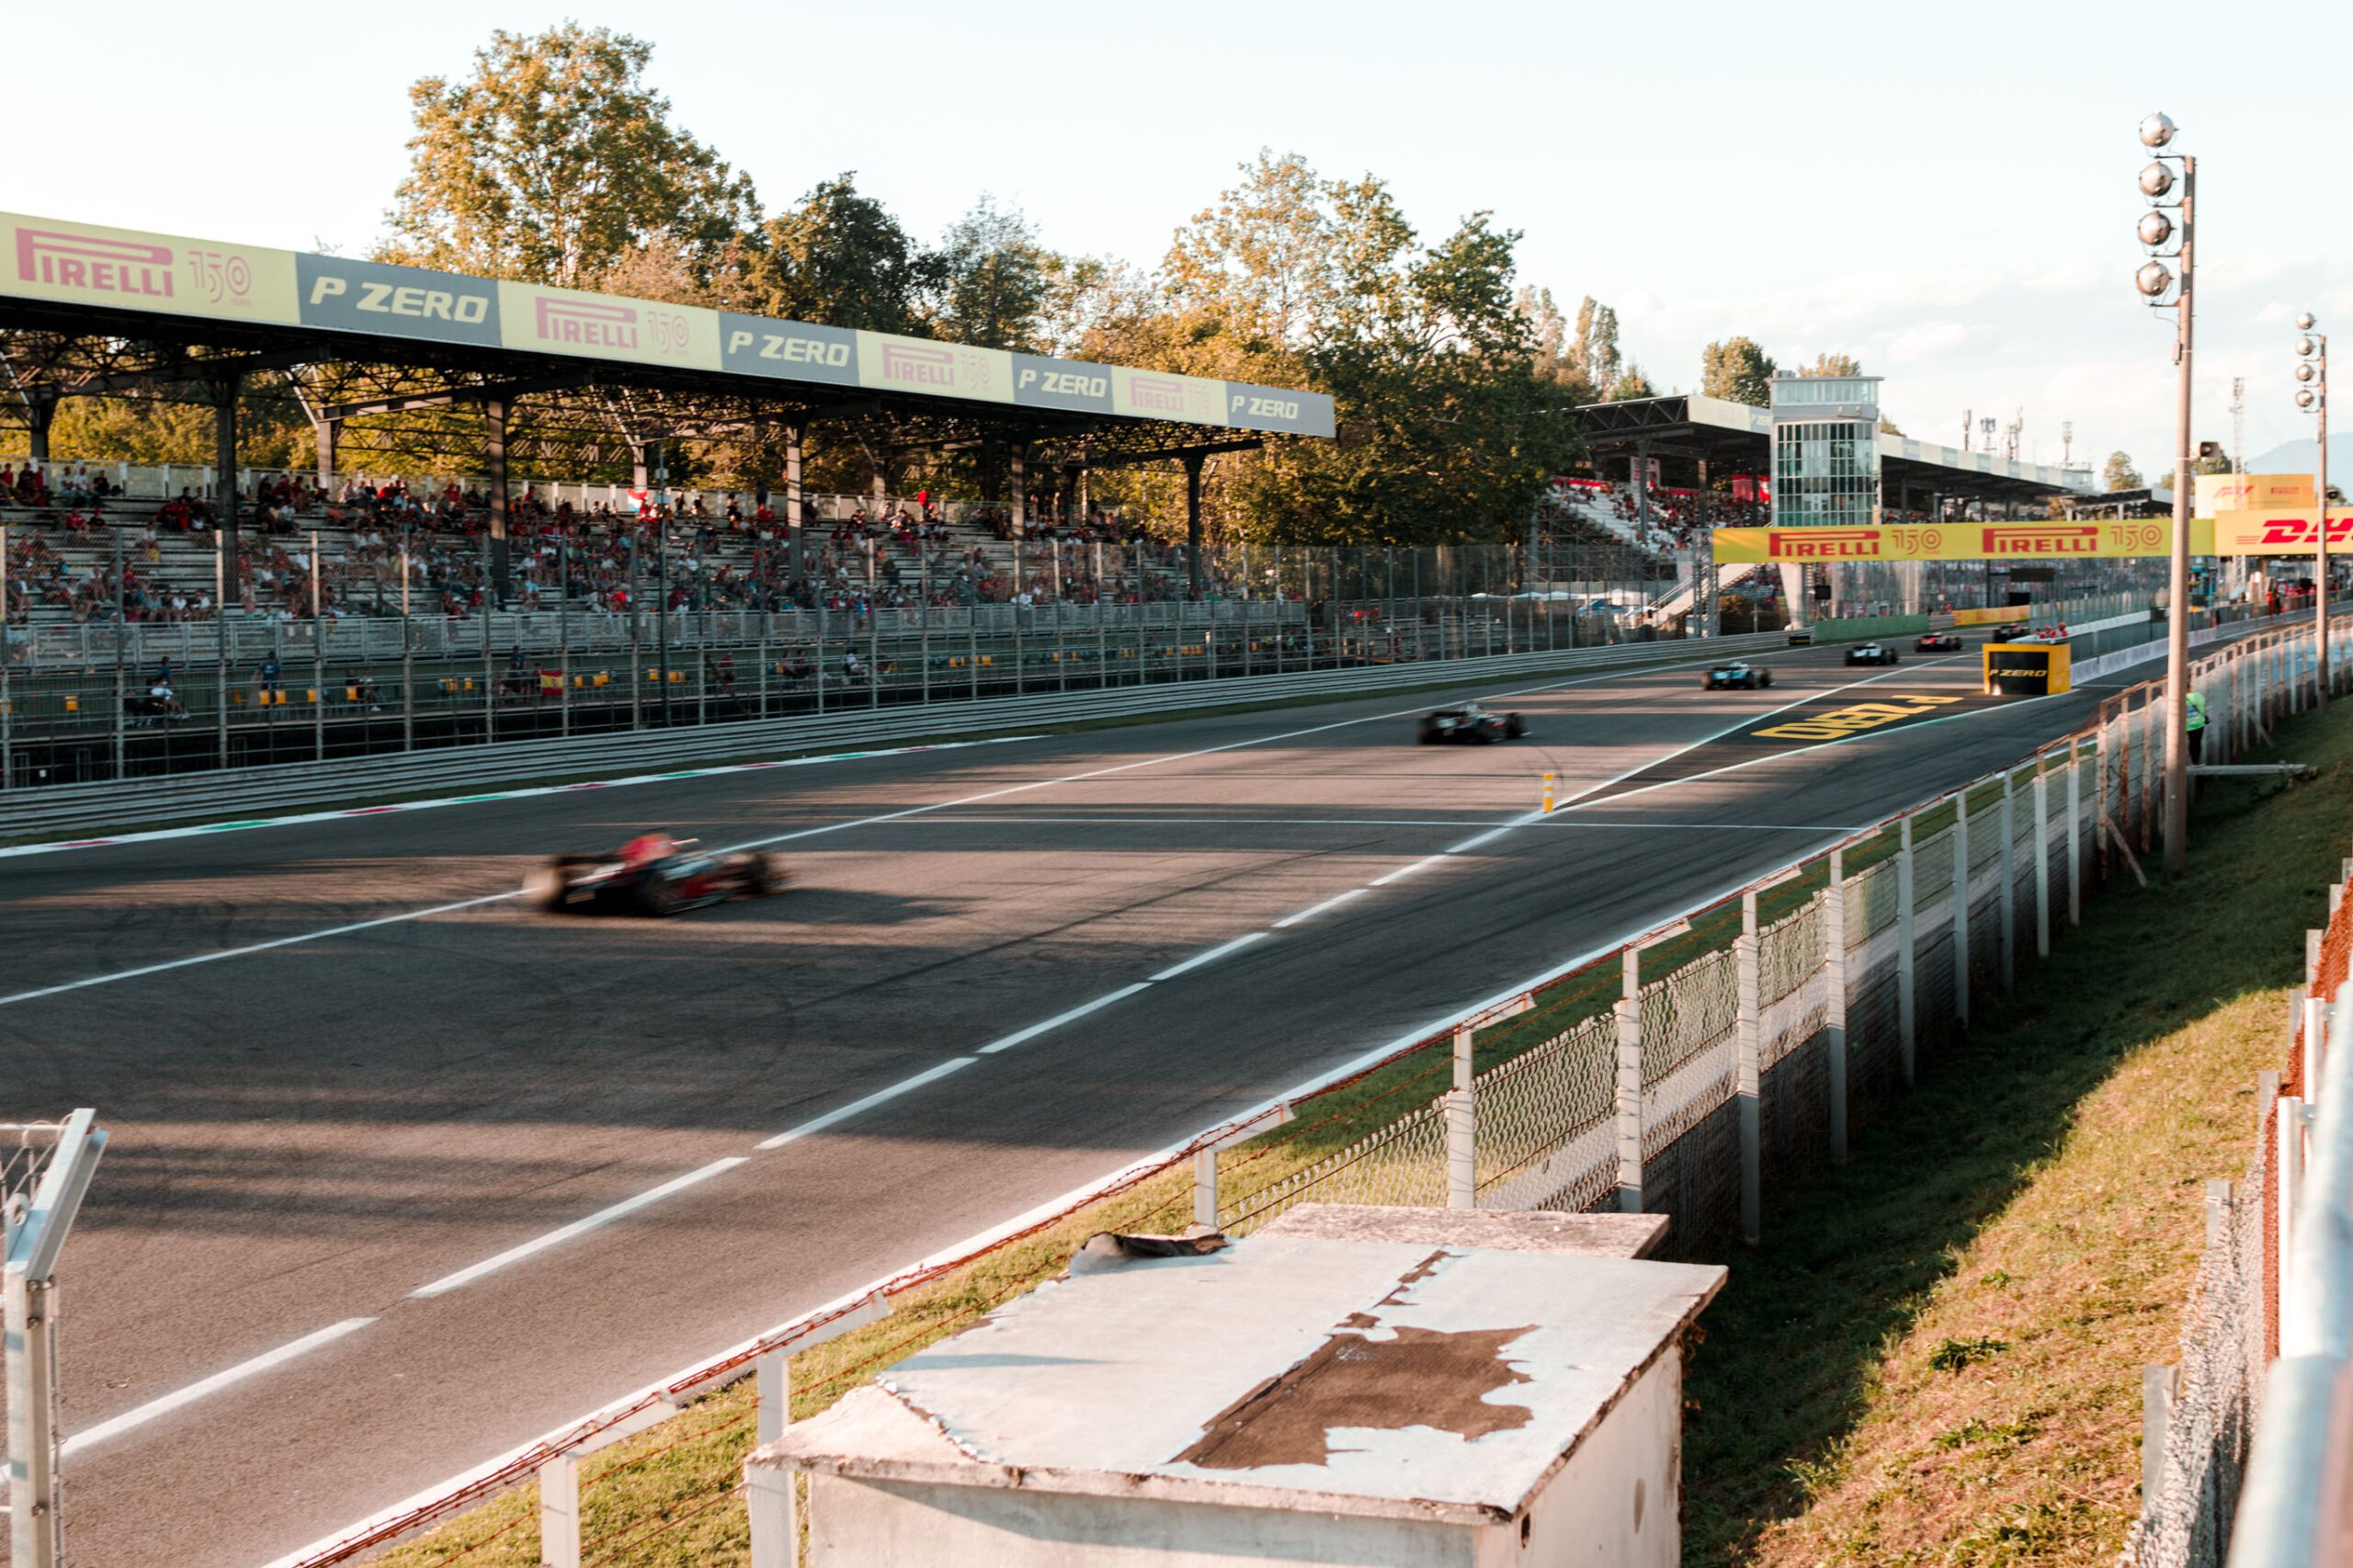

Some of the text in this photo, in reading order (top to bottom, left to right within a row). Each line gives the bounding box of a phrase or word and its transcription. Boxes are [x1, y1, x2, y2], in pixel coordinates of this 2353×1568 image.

[15, 227, 251, 303] PIRELLI 150
[310, 276, 489, 324] P ZERO
[535, 296, 689, 354] PIRELLI 150
[728, 330, 850, 368] P ZERO
[882, 343, 955, 386] PIRELLI
[1018, 369, 1107, 398] P ZERO
[1130, 376, 1184, 412] PIRELLI
[1231, 395, 1245, 413] P
[1248, 397, 1300, 420] ZERO
[1769, 529, 1942, 557] PIRELLI 150
[1983, 525, 2163, 553] PIRELLI 150
[2261, 519, 2353, 544] DH
[1999, 669, 2048, 677] ZERO
